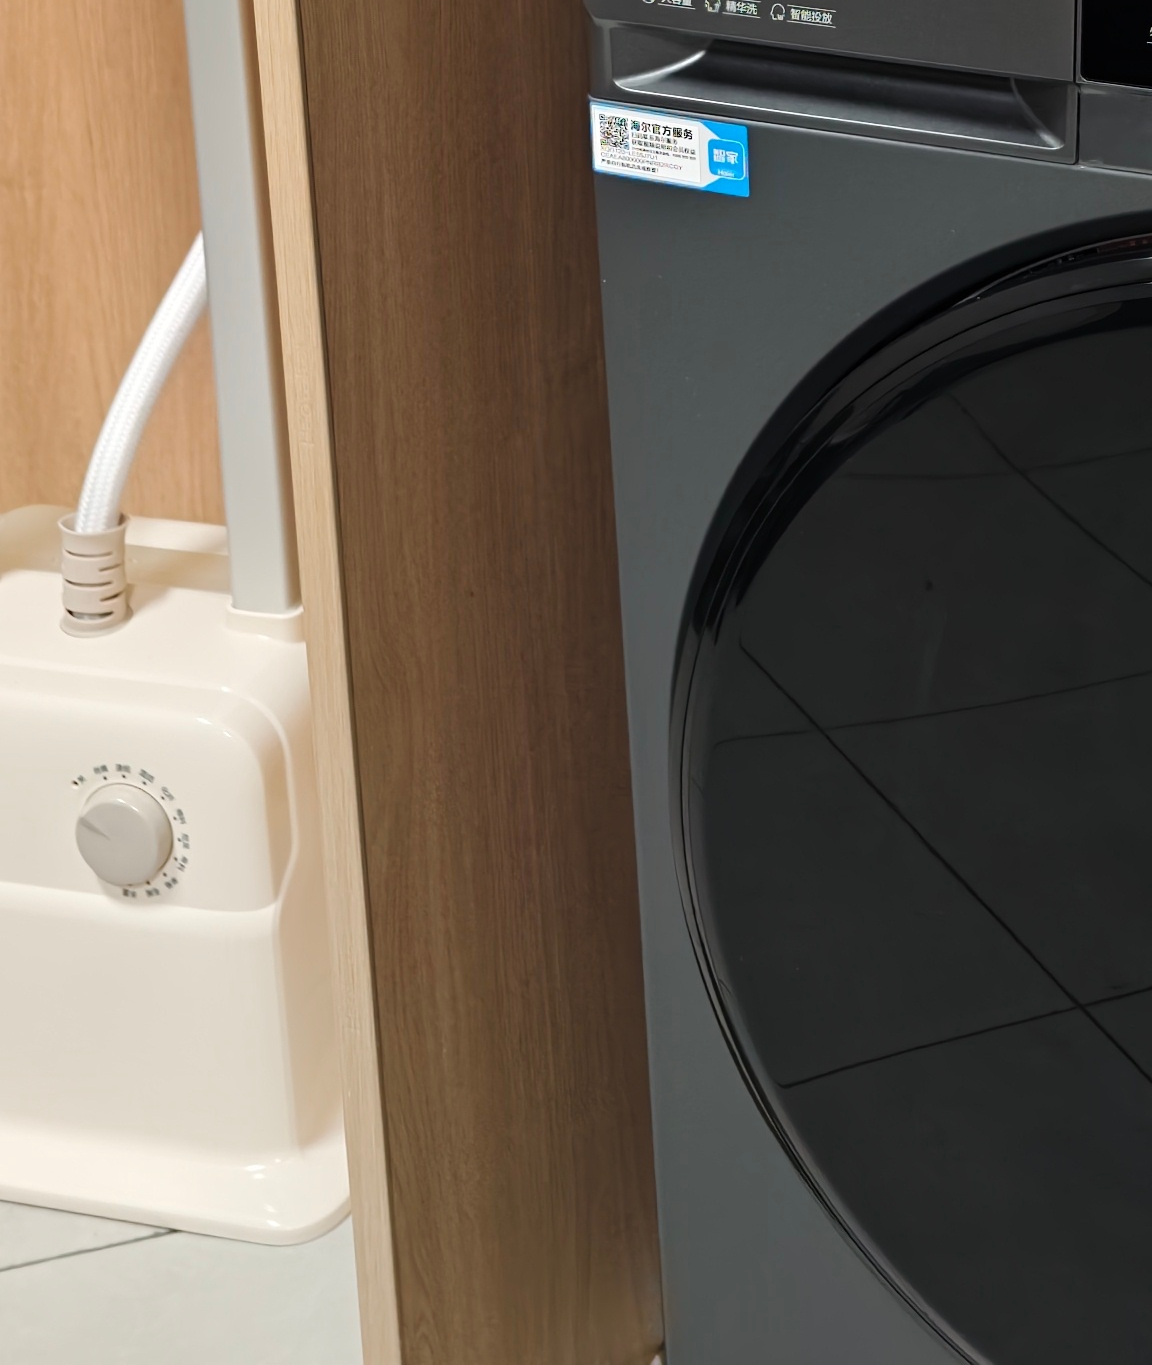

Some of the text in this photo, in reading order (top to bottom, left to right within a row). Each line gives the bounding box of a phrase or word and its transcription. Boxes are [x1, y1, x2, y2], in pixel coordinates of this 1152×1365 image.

[726, 0, 758, 15] 精华洗
[790, 8, 833, 25] 智能投放
[631, 119, 693, 140] 海尔官方服务
[713, 149, 738, 164] 智家
